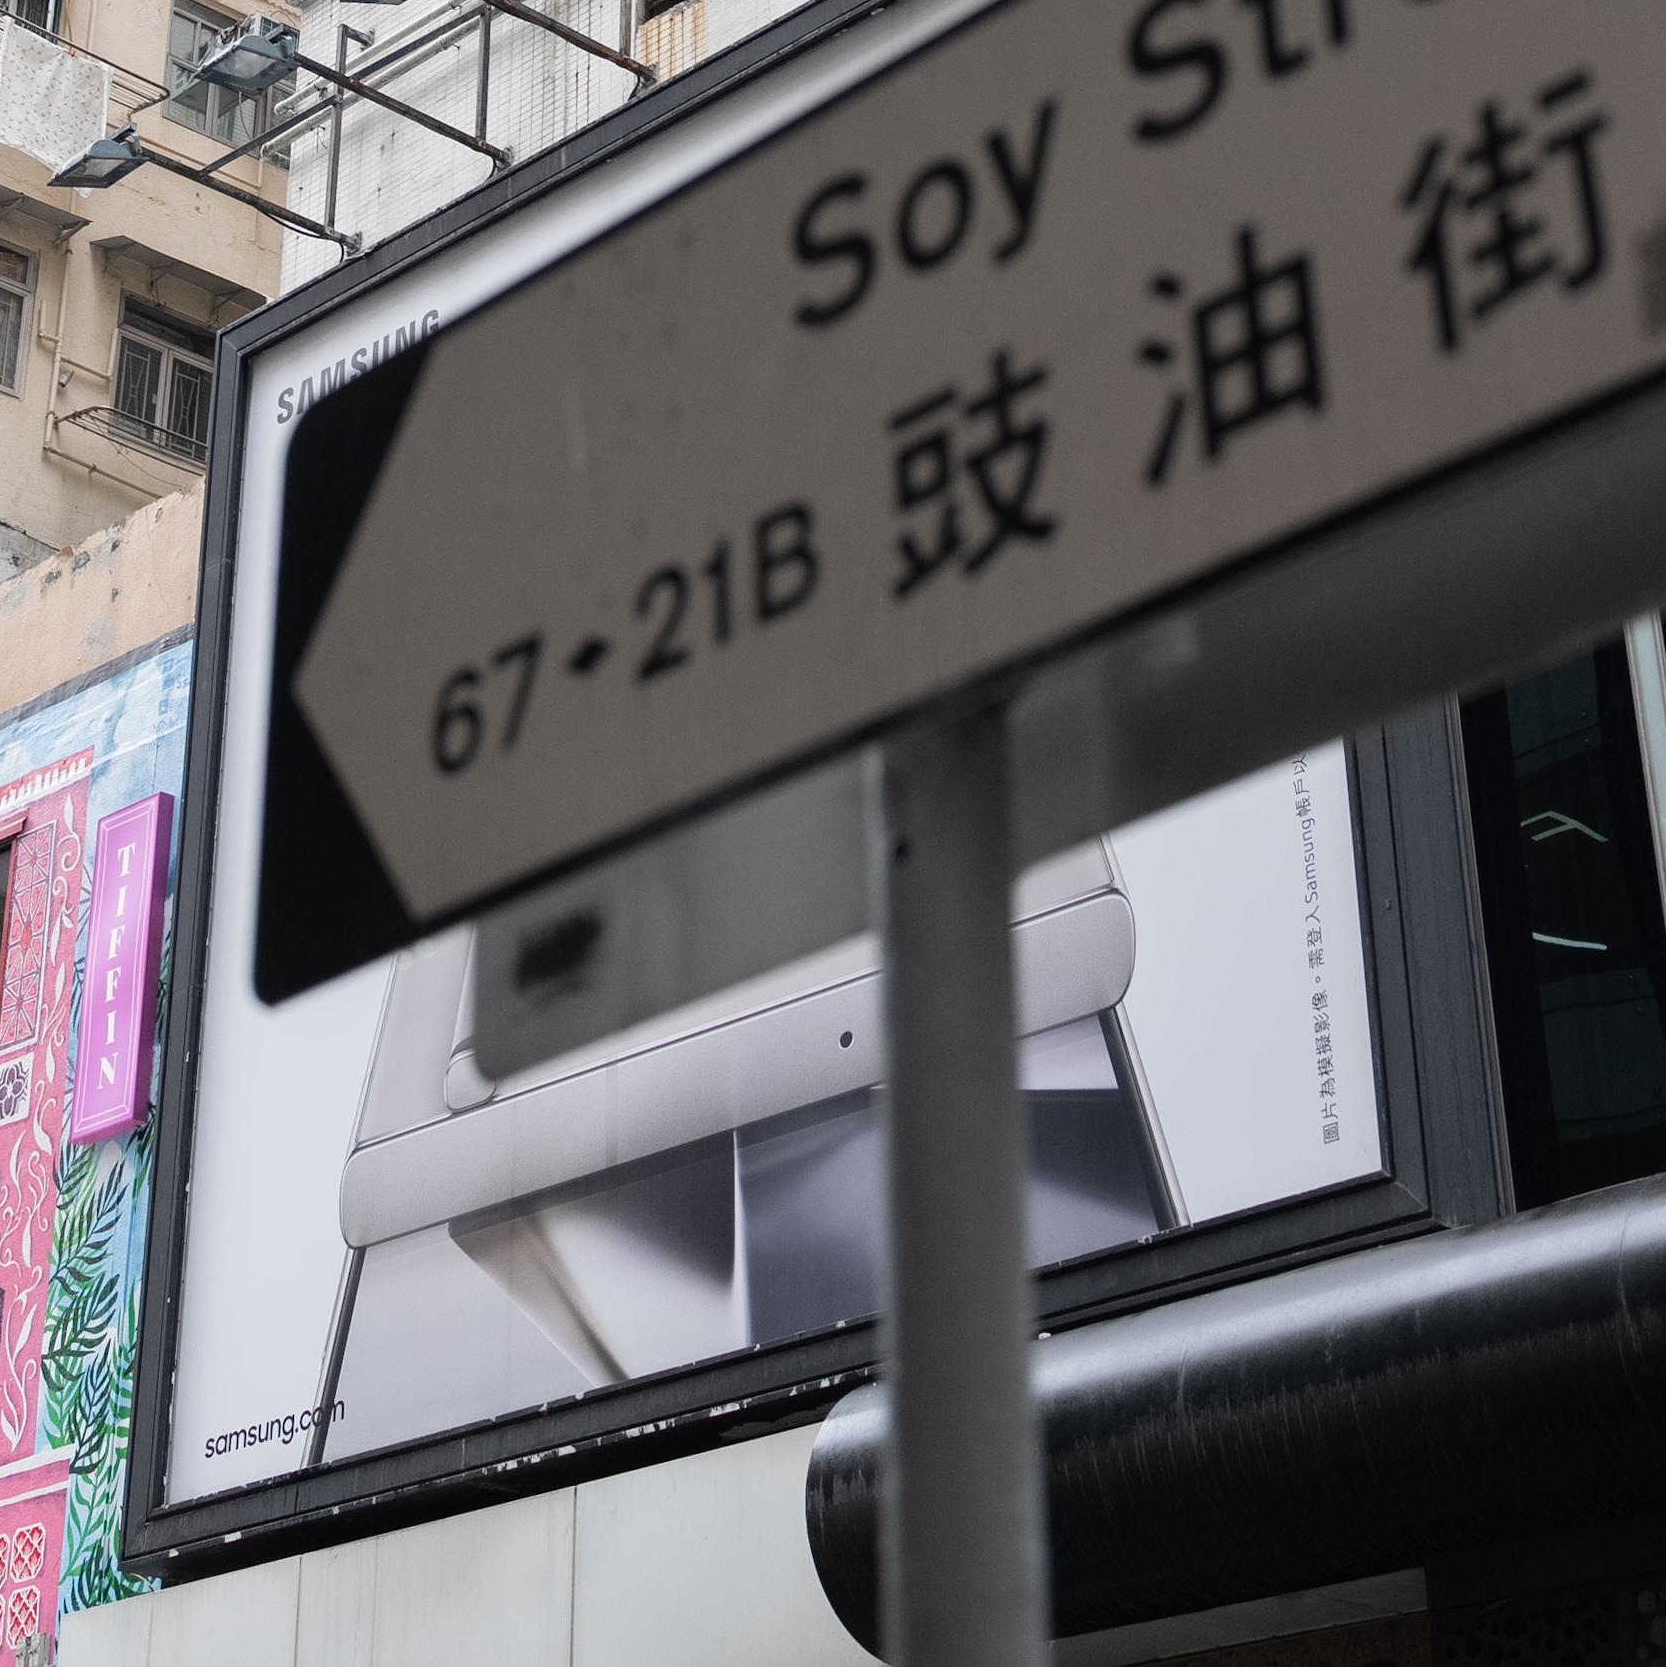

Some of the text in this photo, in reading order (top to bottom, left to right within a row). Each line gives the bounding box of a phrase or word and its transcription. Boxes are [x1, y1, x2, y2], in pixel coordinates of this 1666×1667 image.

[789, 98, 1060, 328] Soy
[277, 309, 440, 424] SAMSUNG
[886, 70, 1614, 606] 豉油街
[97, 842, 136, 1090] TIFFIN
[205, 1399, 345, 1459] samsung.com
